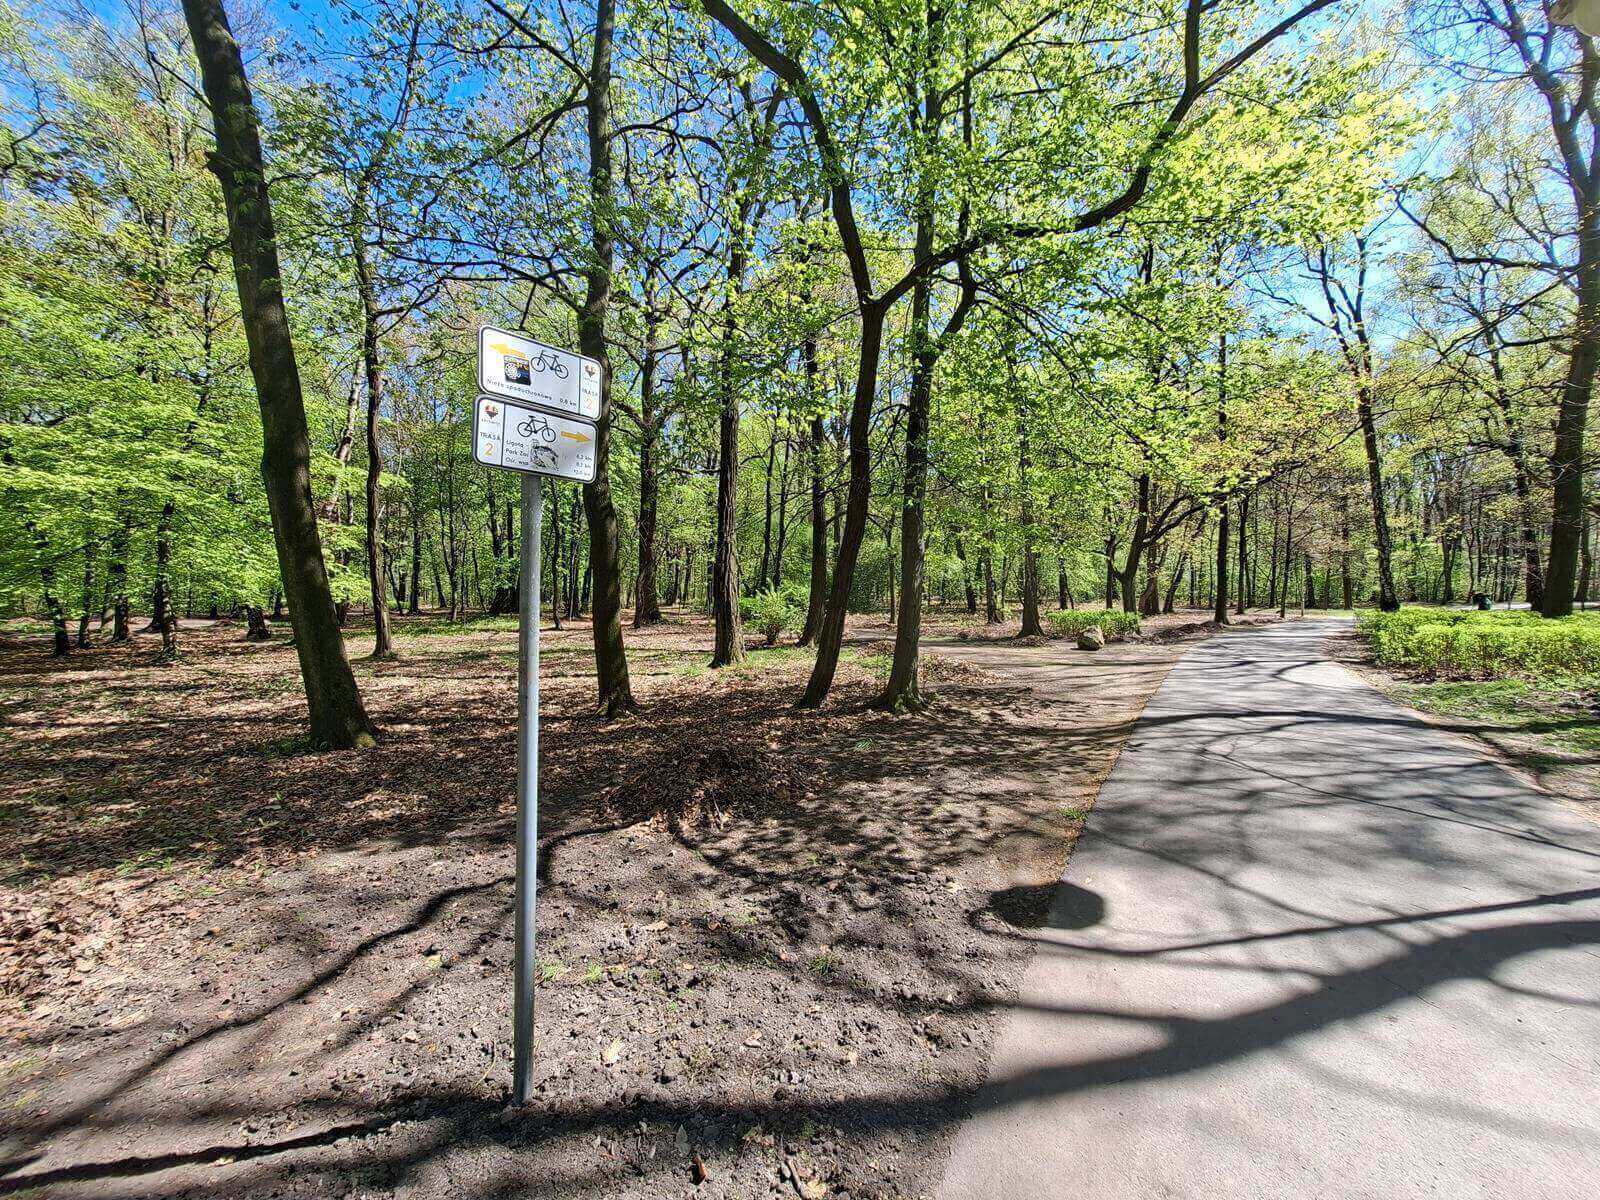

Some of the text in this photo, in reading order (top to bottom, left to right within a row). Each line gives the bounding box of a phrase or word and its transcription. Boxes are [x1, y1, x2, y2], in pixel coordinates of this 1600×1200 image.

[586, 398, 593, 410] 2
[480, 432, 501, 441] TRASA
[485, 442, 494, 456] 2
[506, 440, 524, 448] Ligota
